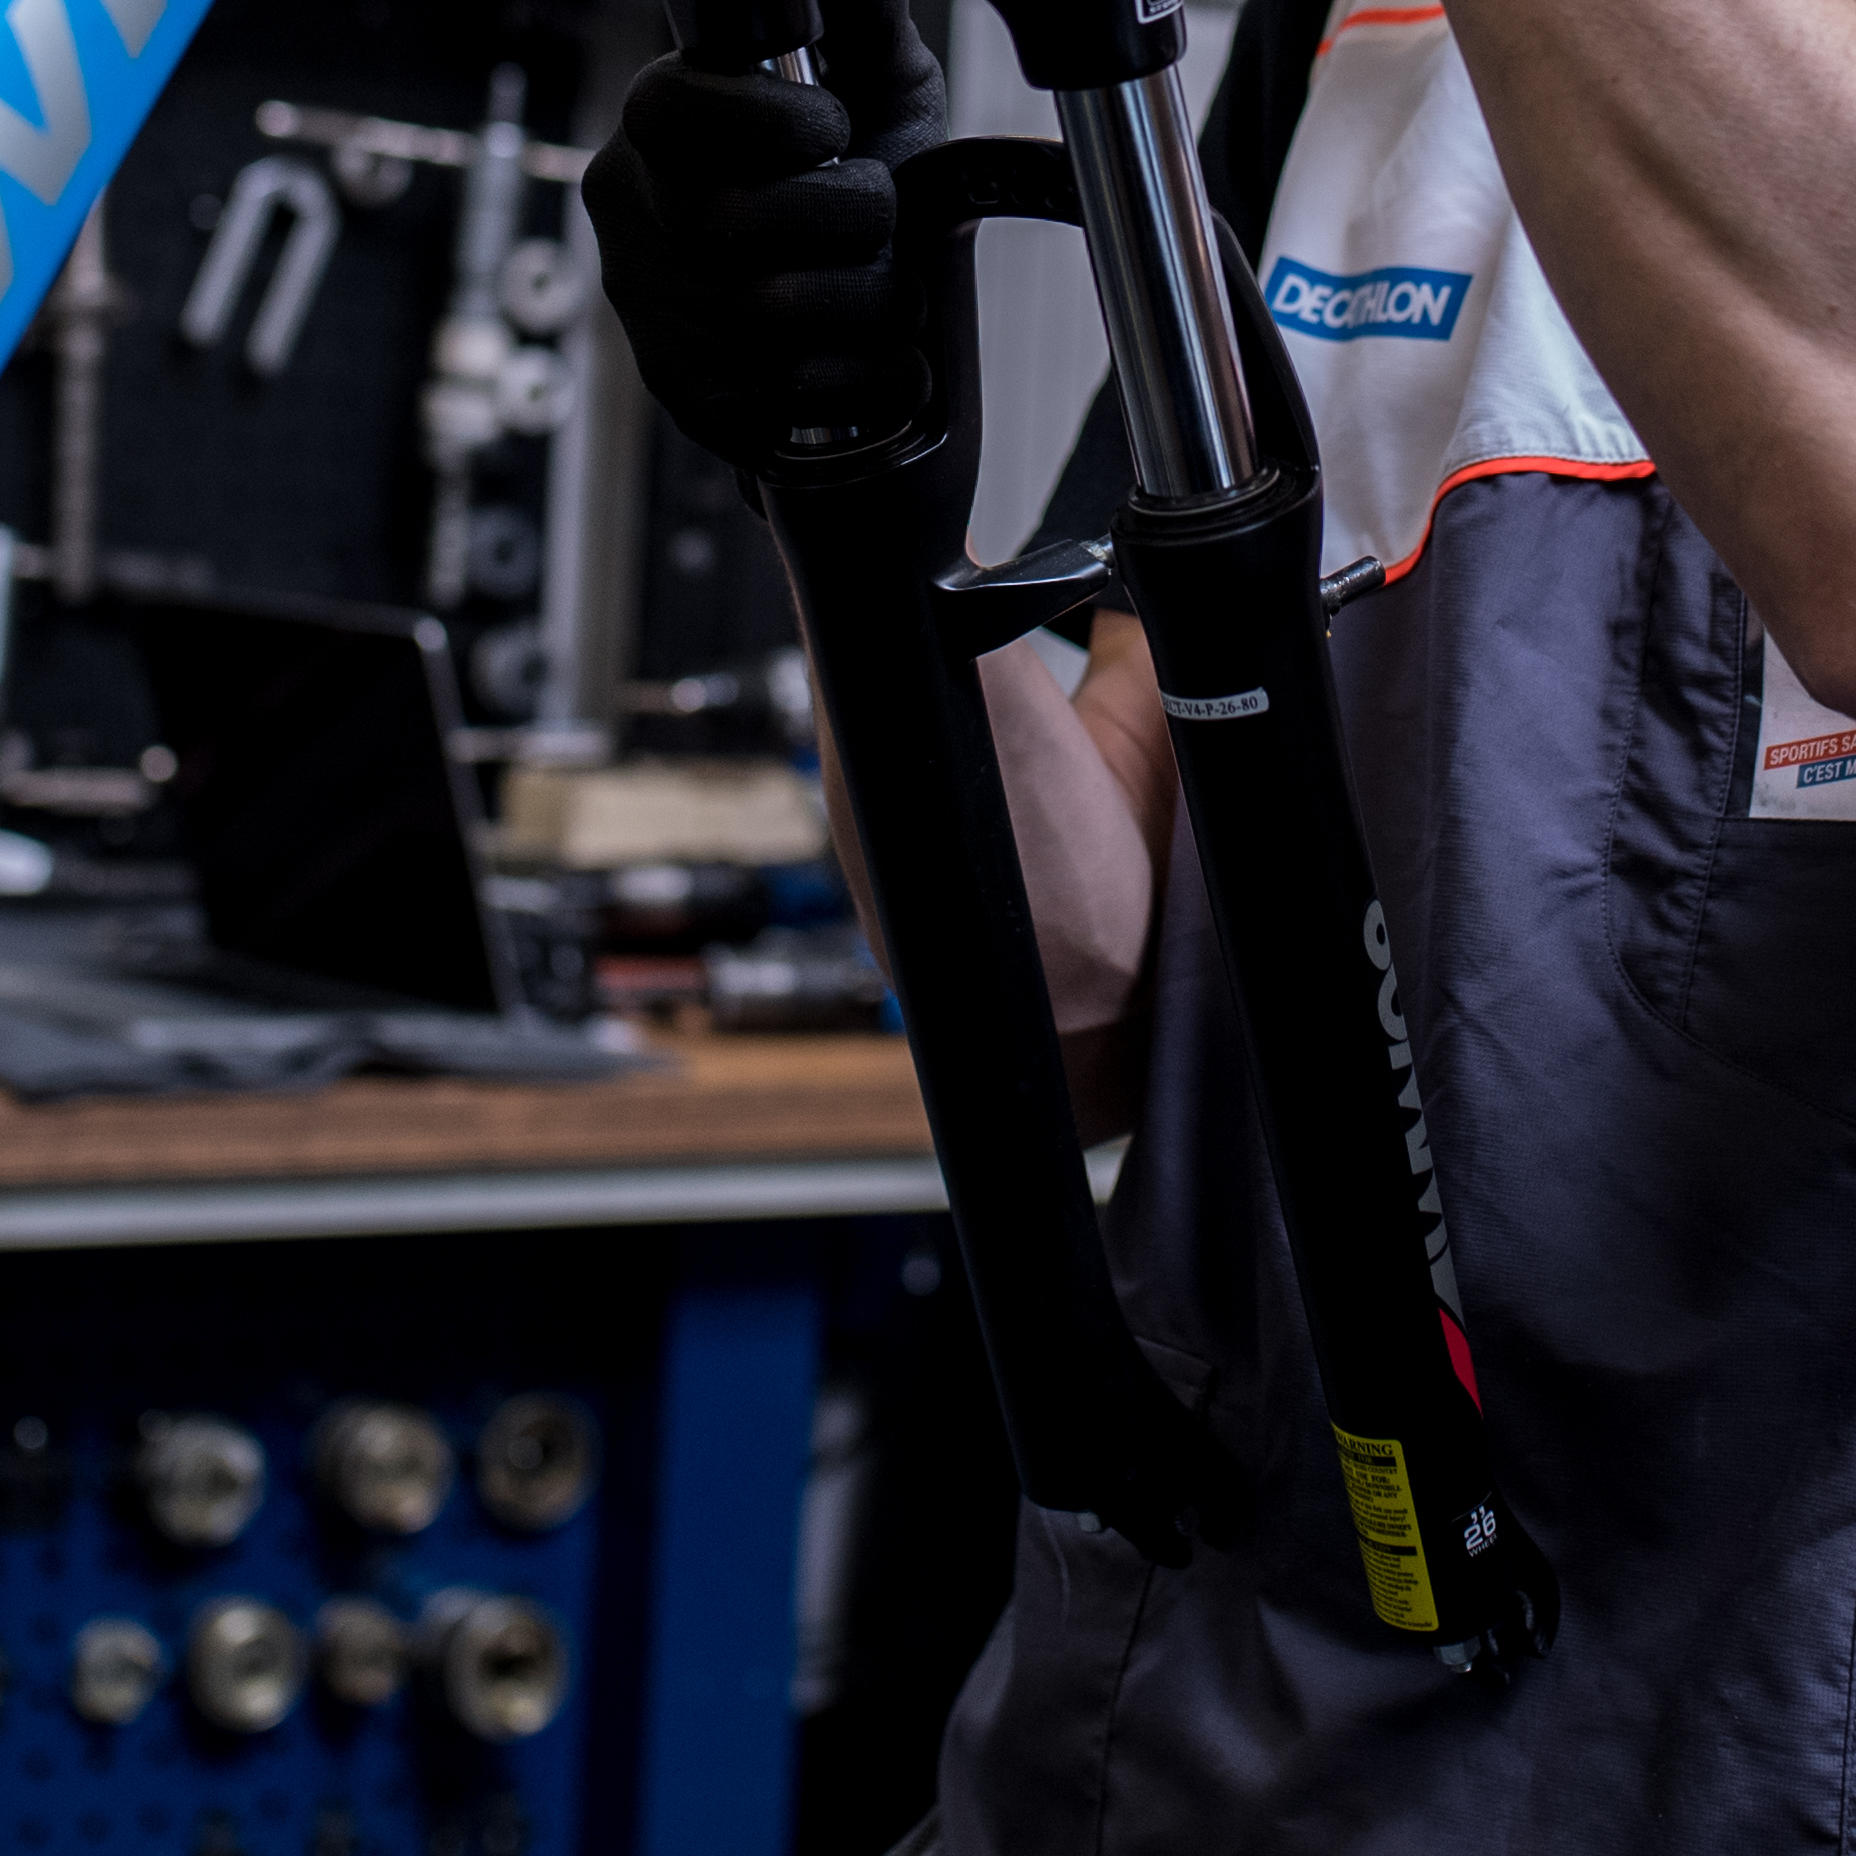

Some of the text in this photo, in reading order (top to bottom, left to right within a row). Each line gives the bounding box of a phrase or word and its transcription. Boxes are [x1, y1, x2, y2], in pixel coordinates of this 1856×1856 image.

[1769, 738, 1839, 766] SPORTIFS
[1803, 763, 1842, 784] C'EST
[1336, 1431, 1394, 1456] WARNING
